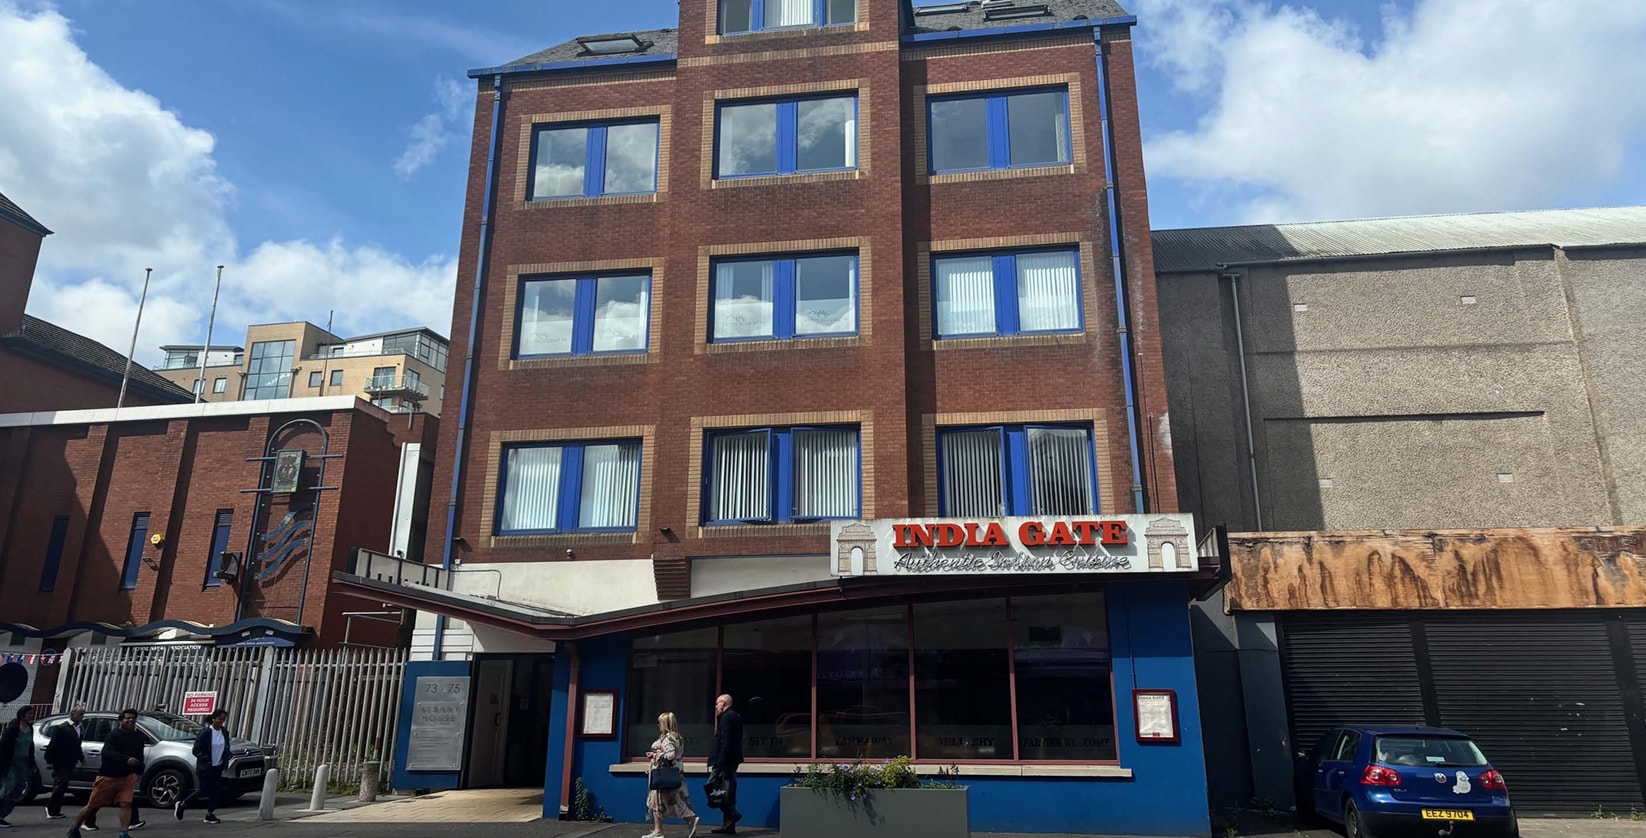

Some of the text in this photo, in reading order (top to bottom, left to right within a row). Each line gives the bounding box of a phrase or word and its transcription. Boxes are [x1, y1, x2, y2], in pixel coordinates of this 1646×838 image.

[893, 520, 1128, 548] INDIA GATE
[894, 550, 1131, 572] Authentic Indian Cuisine
[425, 683, 438, 694] 73
[447, 683, 461, 694] 75
[422, 714, 457, 722] HOUSE
[748, 736, 766, 746] SIT
[1425, 809, 1469, 818] EEZ 9704
